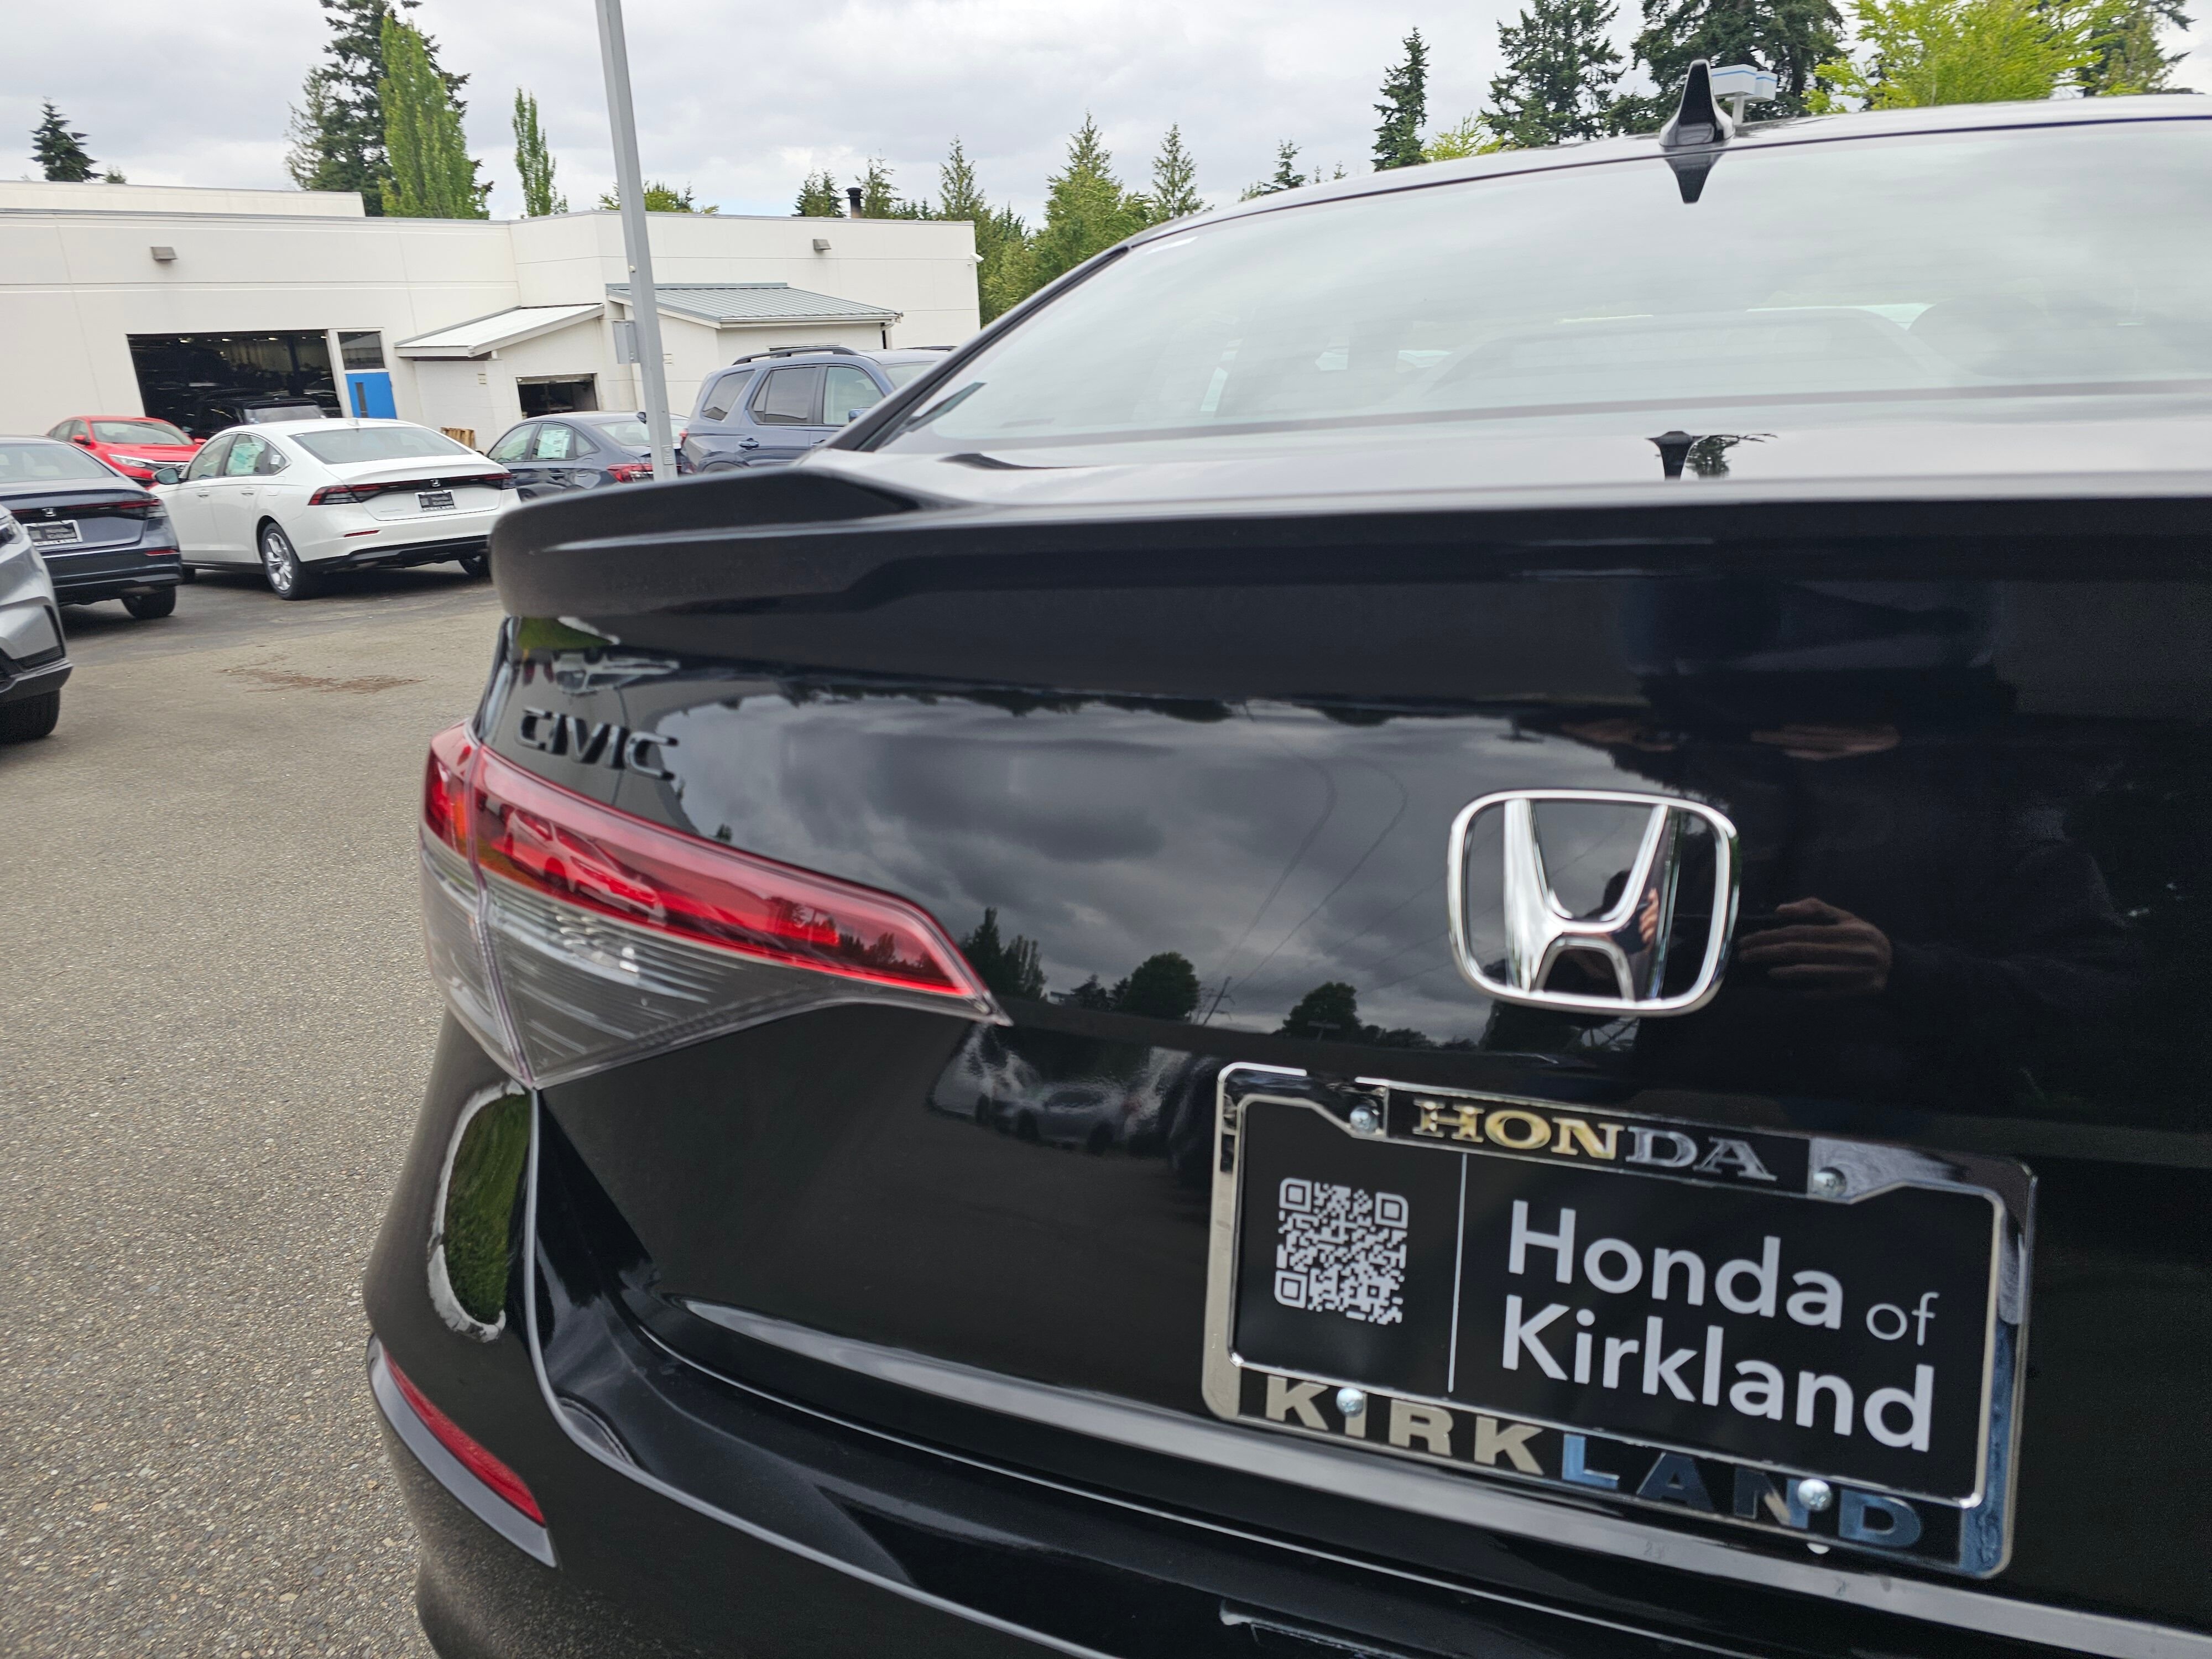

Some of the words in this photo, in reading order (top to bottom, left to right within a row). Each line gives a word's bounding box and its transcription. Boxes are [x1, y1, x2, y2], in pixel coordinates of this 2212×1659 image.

[514, 706, 679, 781] CIVIC
[1413, 1098, 1777, 1182] HONDA
[1509, 1200, 1842, 1329] Honda
[1866, 1292, 1938, 1345] of
[1503, 1295, 1934, 1452] Kirkland
[1266, 1374, 1922, 1547] KIRKLAND
